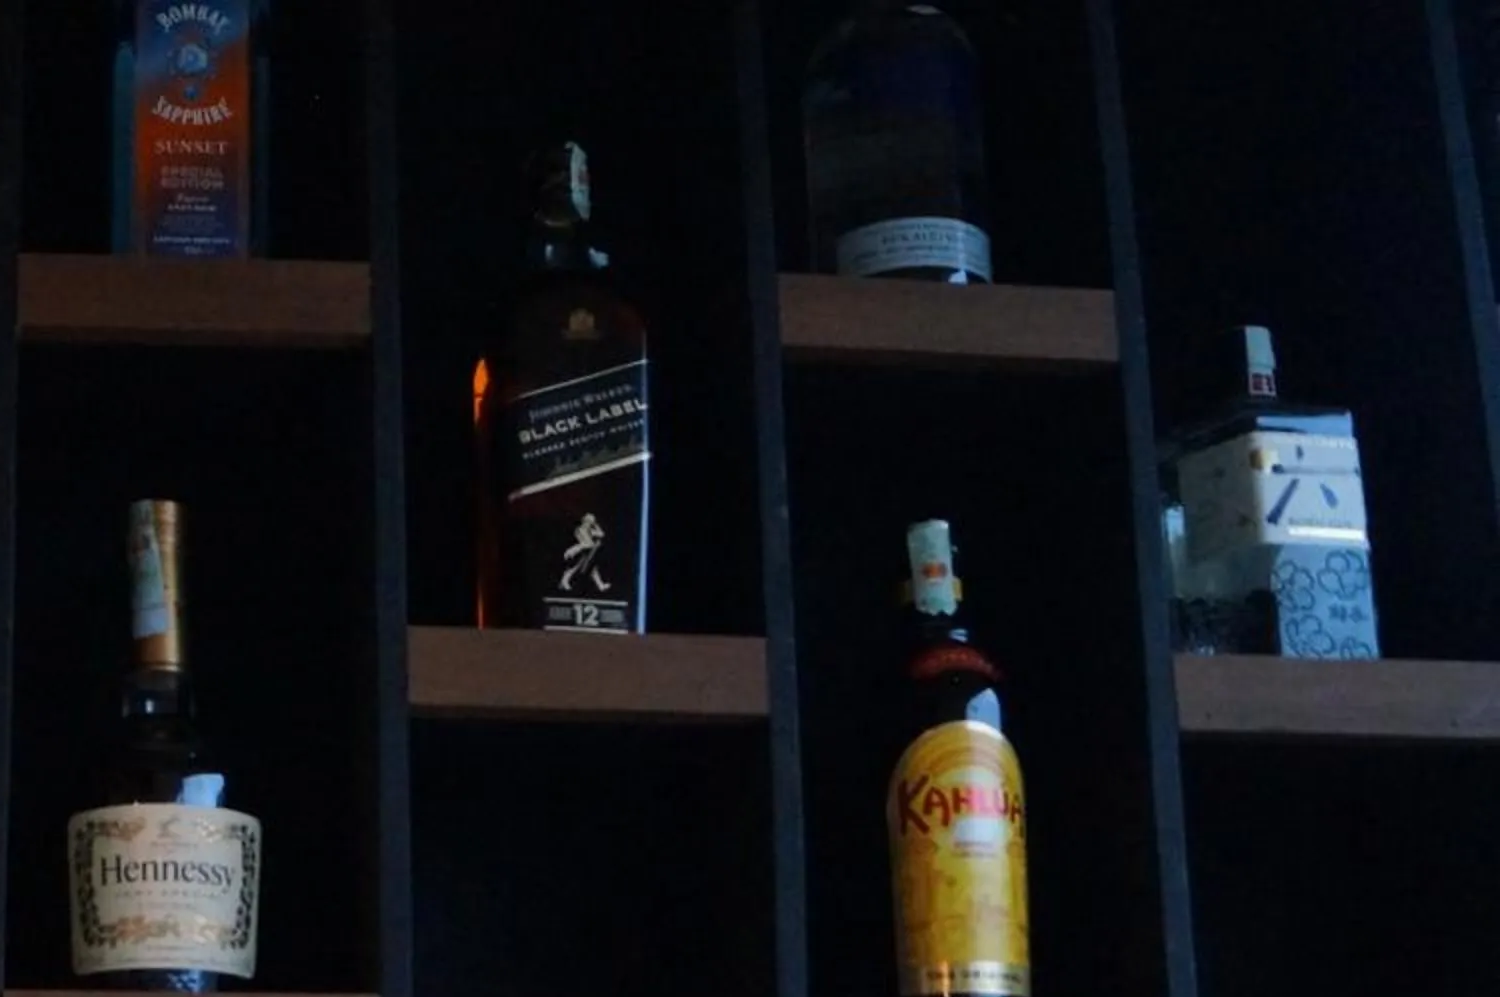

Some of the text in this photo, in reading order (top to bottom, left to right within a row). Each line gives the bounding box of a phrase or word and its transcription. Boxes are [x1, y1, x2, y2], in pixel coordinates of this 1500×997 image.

[152, 95, 233, 126] SAPPHIRE
[154, 140, 228, 155] SUNSET
[518, 398, 648, 445] BLACK LABEL
[572, 604, 600, 626] 12
[101, 855, 235, 894] Hennessy
